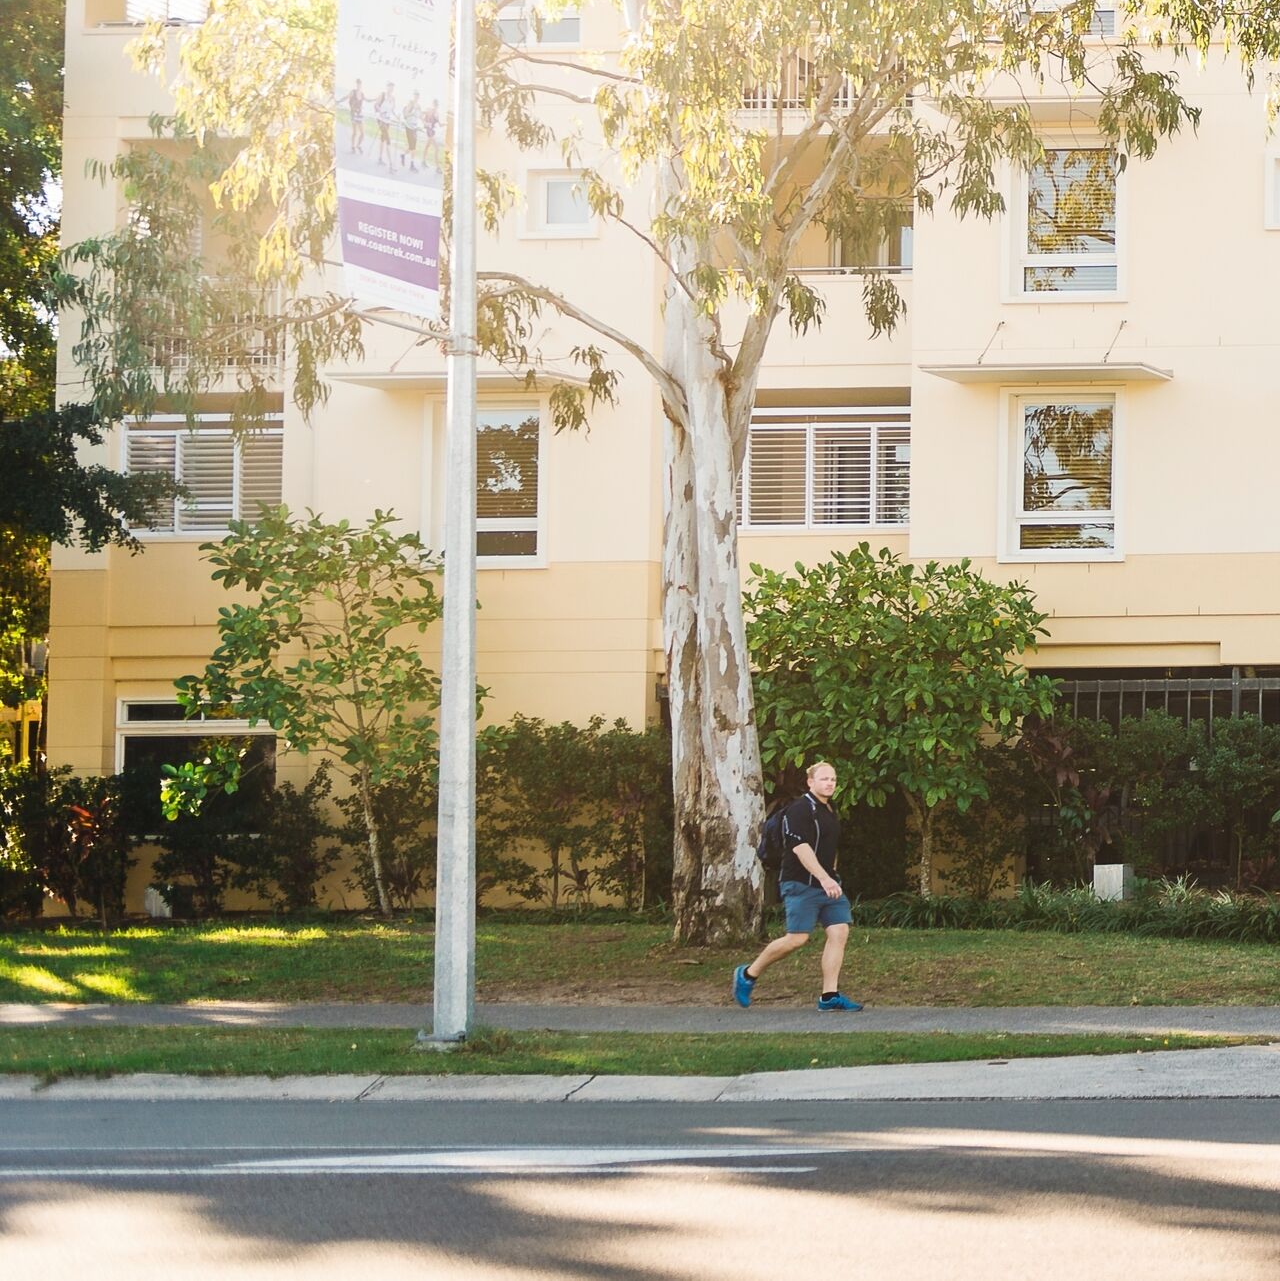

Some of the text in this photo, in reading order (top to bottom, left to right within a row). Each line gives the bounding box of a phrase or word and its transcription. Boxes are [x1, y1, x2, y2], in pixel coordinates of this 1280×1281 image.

[368, 48, 425, 78] Challenge
[346, 233, 437, 267] www.coastrek.com.au
[358, 221, 424, 250] REGISTER NOW!
